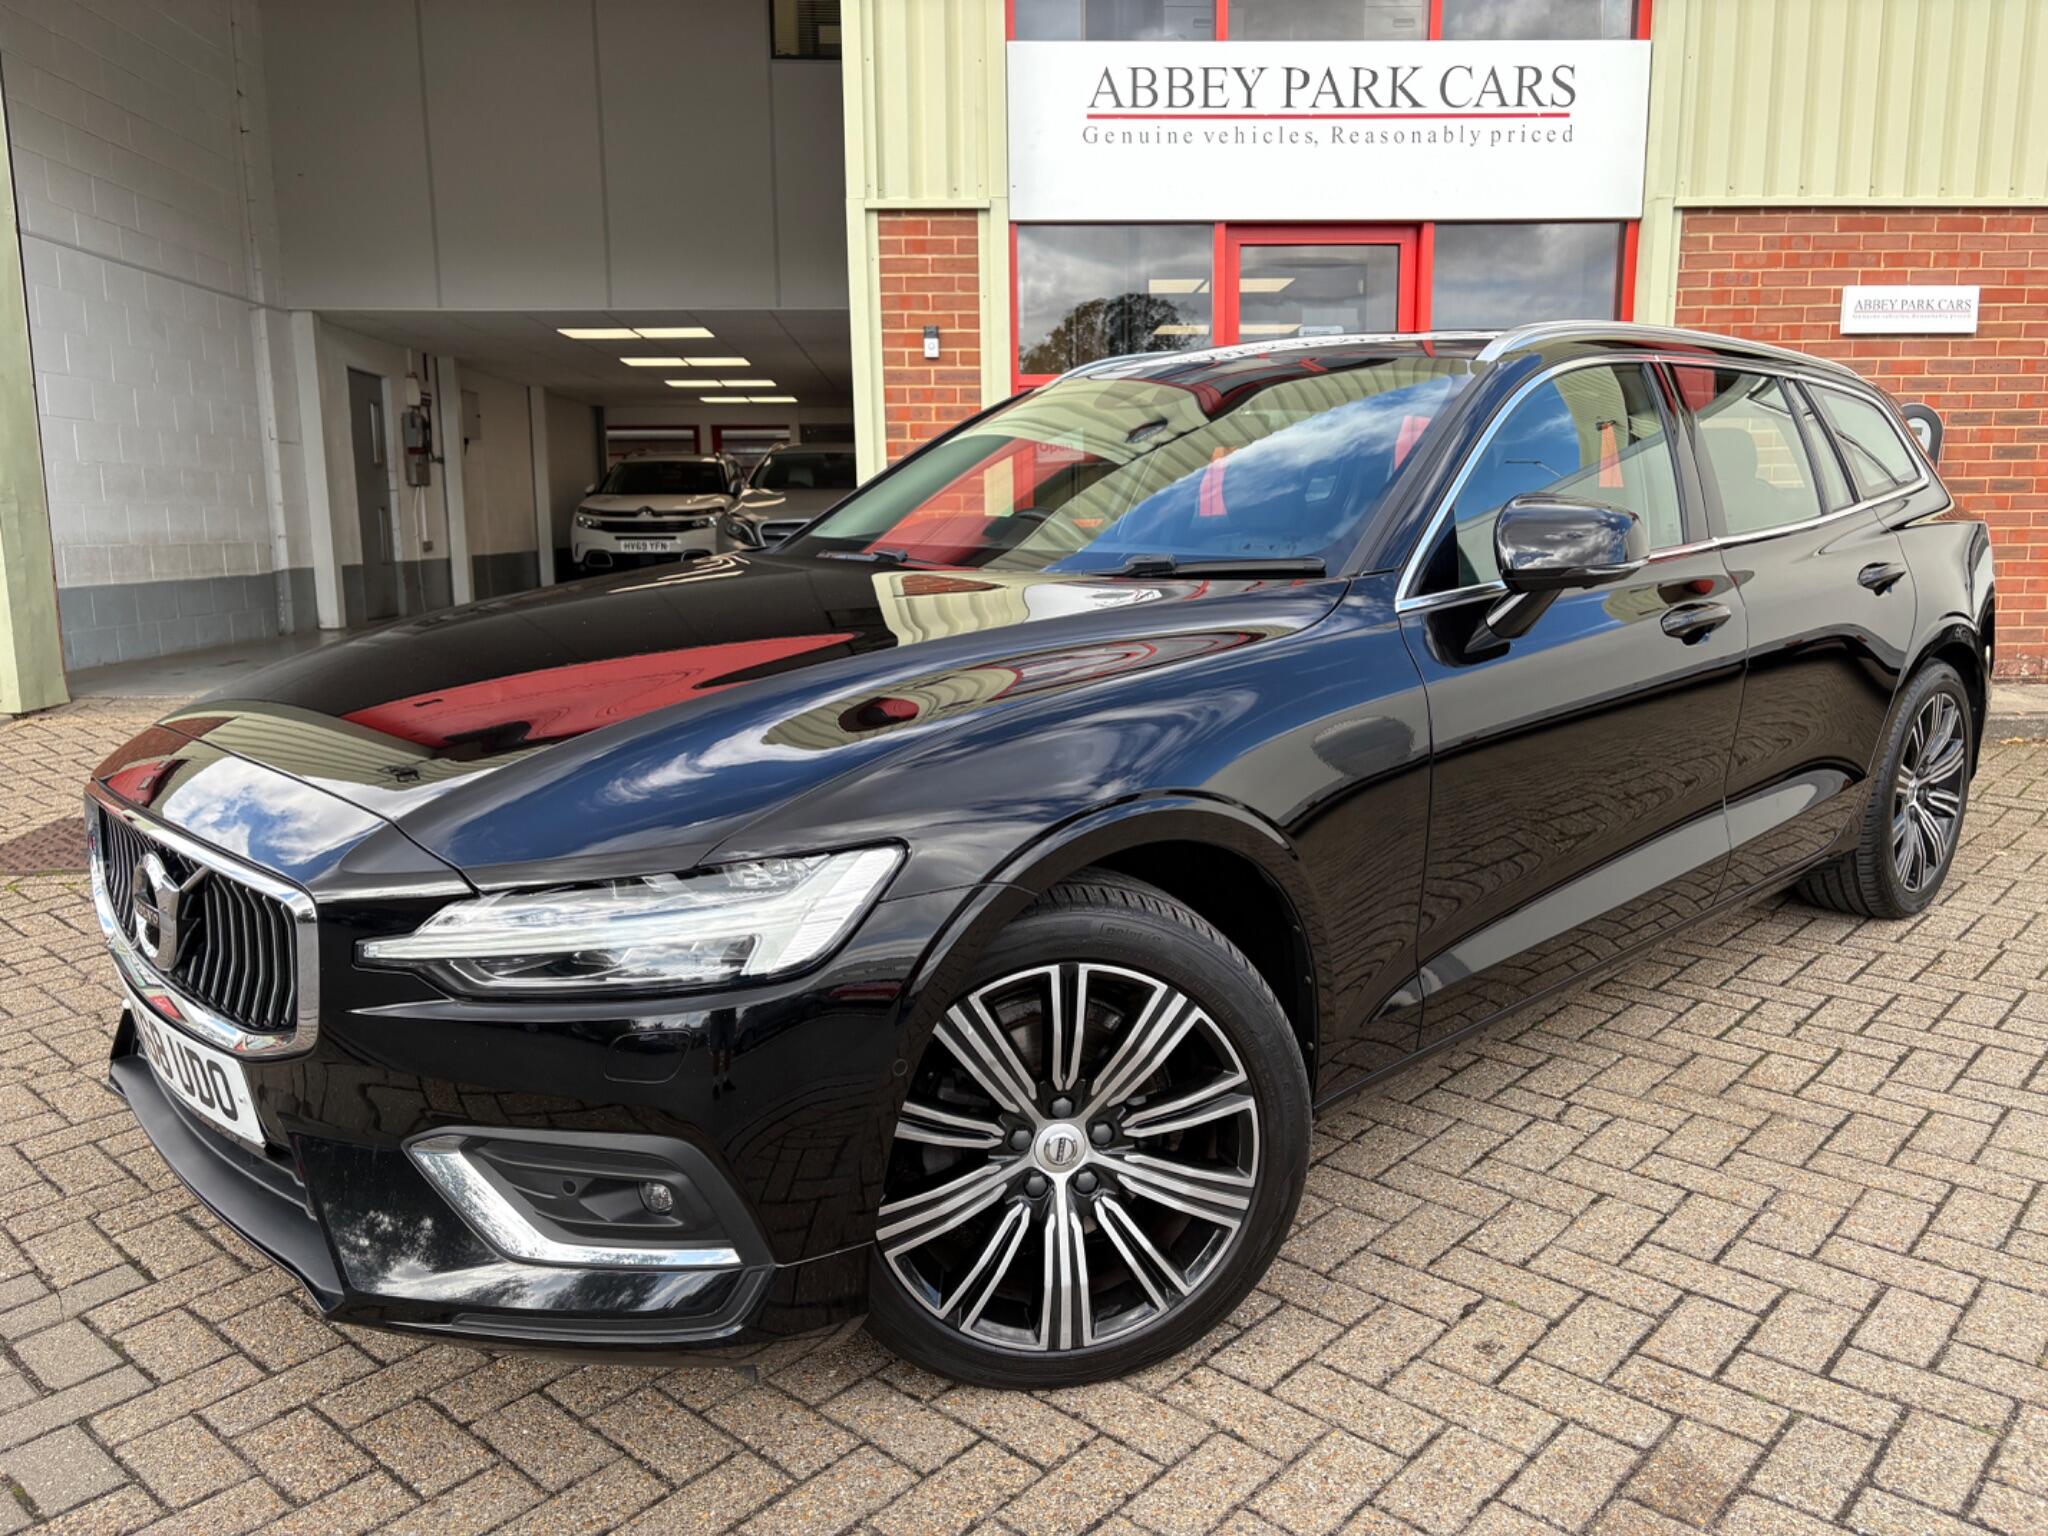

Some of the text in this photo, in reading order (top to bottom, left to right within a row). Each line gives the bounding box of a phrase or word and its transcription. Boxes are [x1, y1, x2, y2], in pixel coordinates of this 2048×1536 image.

[1088, 64, 1577, 109] ABBEY PARK CARS
[1082, 124, 1574, 148] Genuine vehicles, Reasonably priced
[1855, 298, 1972, 310] ABBEY PARK CARS
[165, 1033, 239, 1122] UDO
